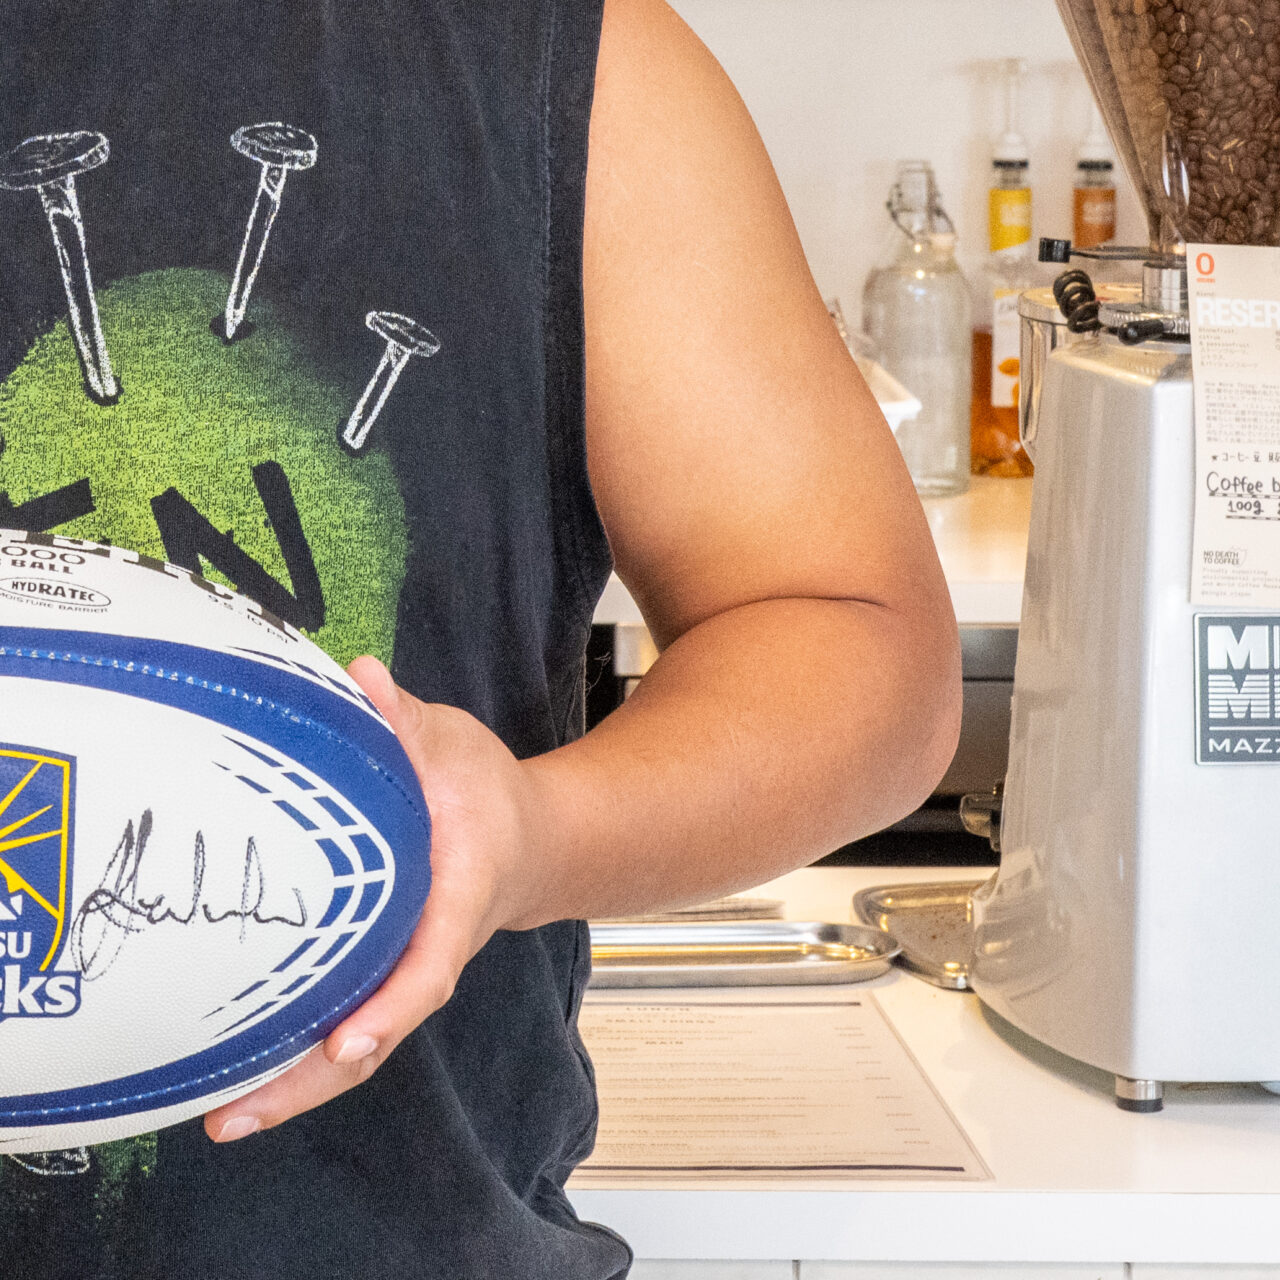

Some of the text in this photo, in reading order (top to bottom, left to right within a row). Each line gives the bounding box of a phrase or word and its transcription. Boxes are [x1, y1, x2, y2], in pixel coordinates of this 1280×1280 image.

[1206, 471, 1264, 494] Coffee
[1203, 550, 1239, 559] NO DEATH
[1214, 558, 1240, 566] COFFEE
[9, 558, 75, 575] BALL
[10, 580, 97, 603] HYDRATEC
[57, 603, 109, 614] BARRIER
[1208, 737, 1280, 754] MAZ
